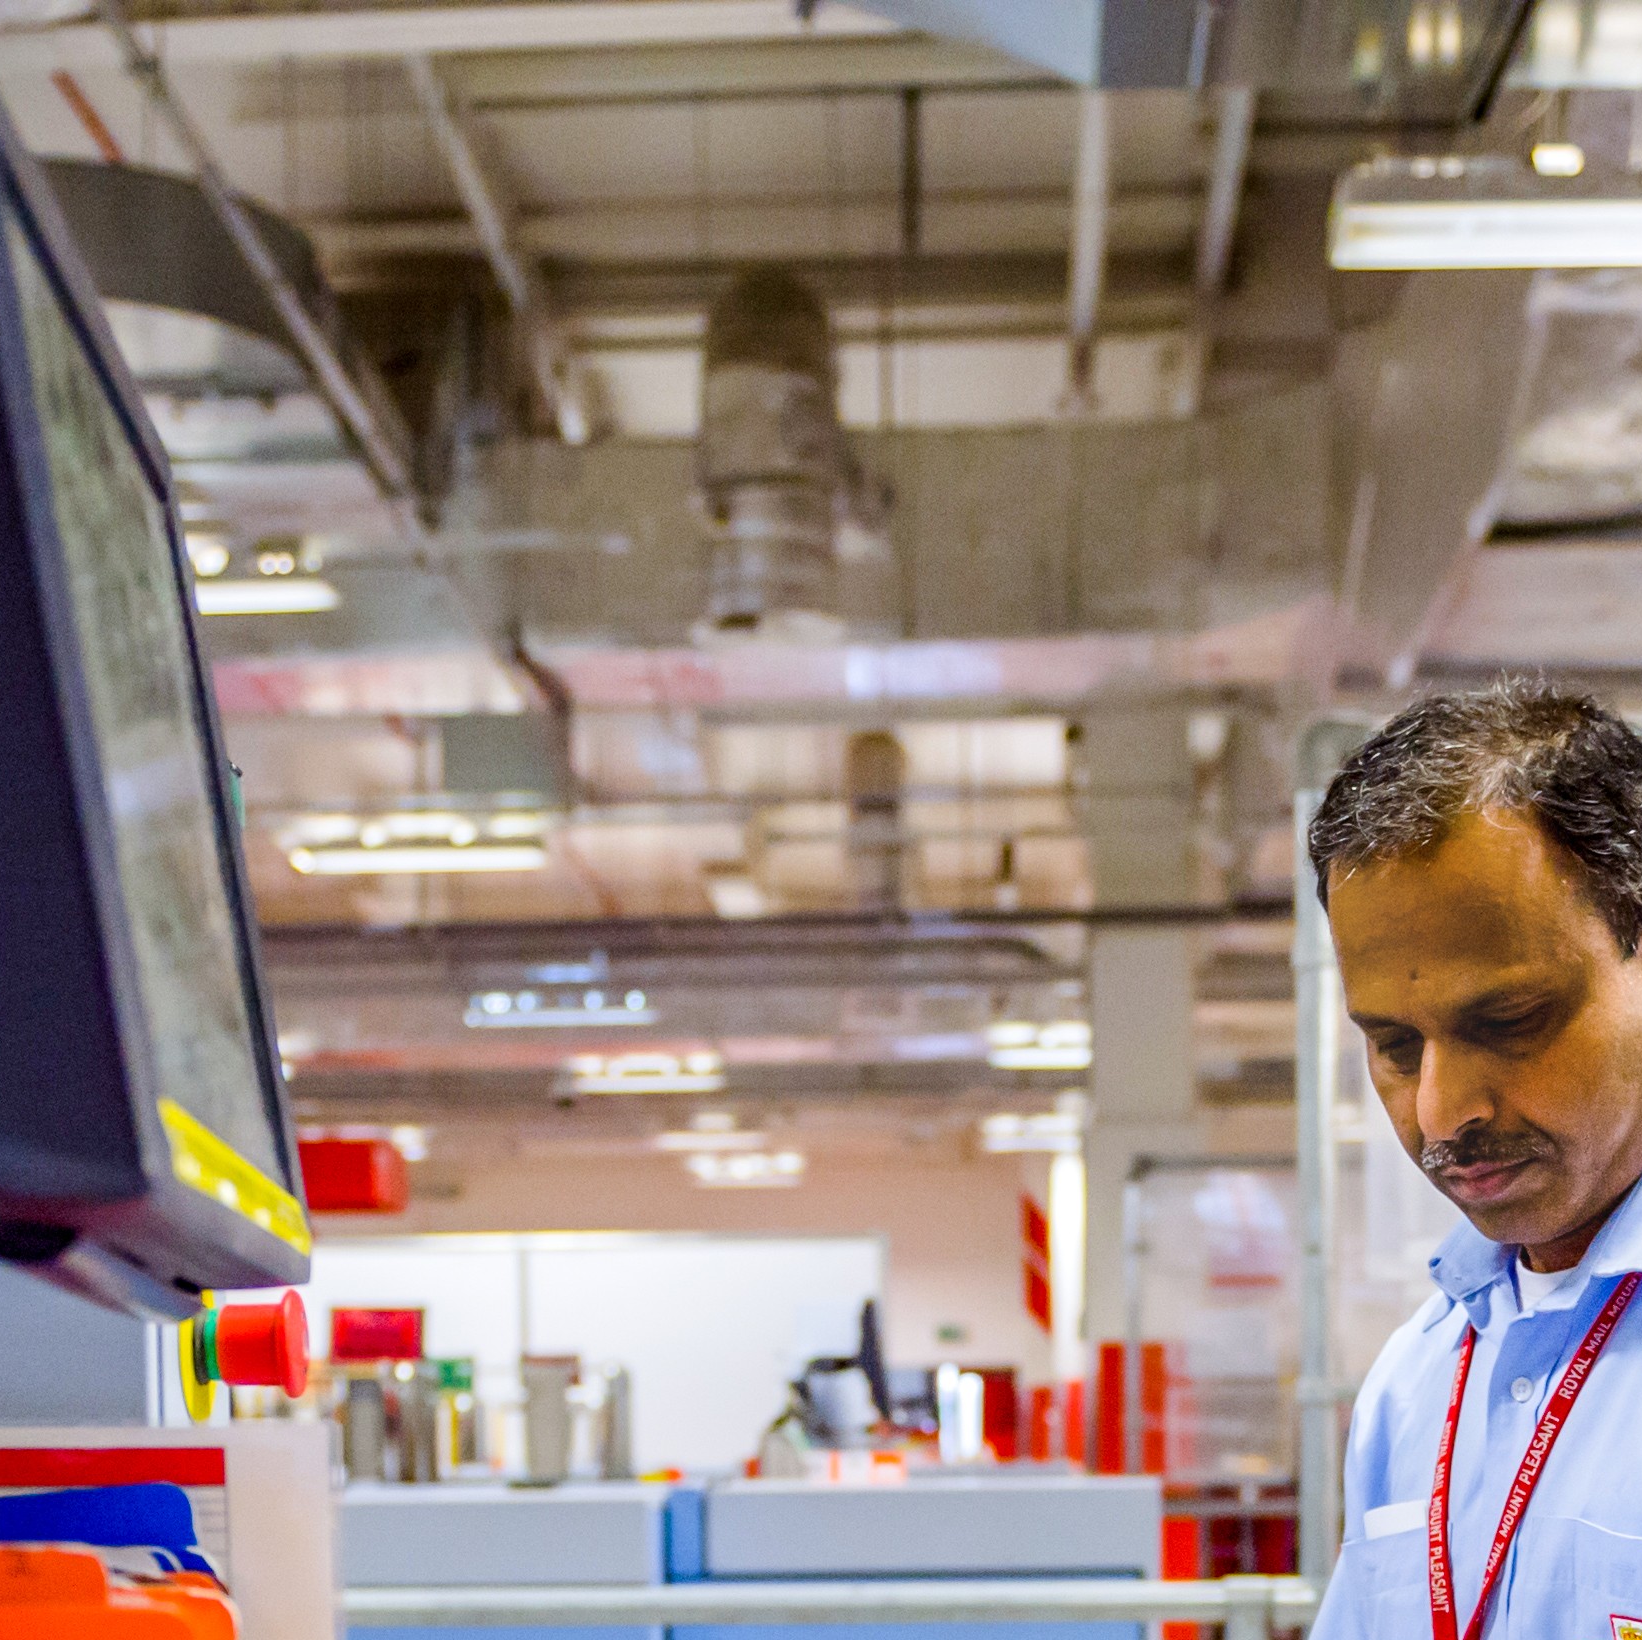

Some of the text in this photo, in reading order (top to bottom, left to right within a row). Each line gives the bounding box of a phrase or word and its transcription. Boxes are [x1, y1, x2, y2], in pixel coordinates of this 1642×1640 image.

[1558, 1356, 1593, 1400] ROYAL
[1584, 1321, 1613, 1354] MAIL
[1432, 1461, 1446, 1495] MAIL
[1486, 1410, 1560, 1574] MAIL MOUNT PLEASANT
[1429, 1495, 1443, 1542] MOUNT
[1430, 1544, 1450, 1614] PLEASANT
